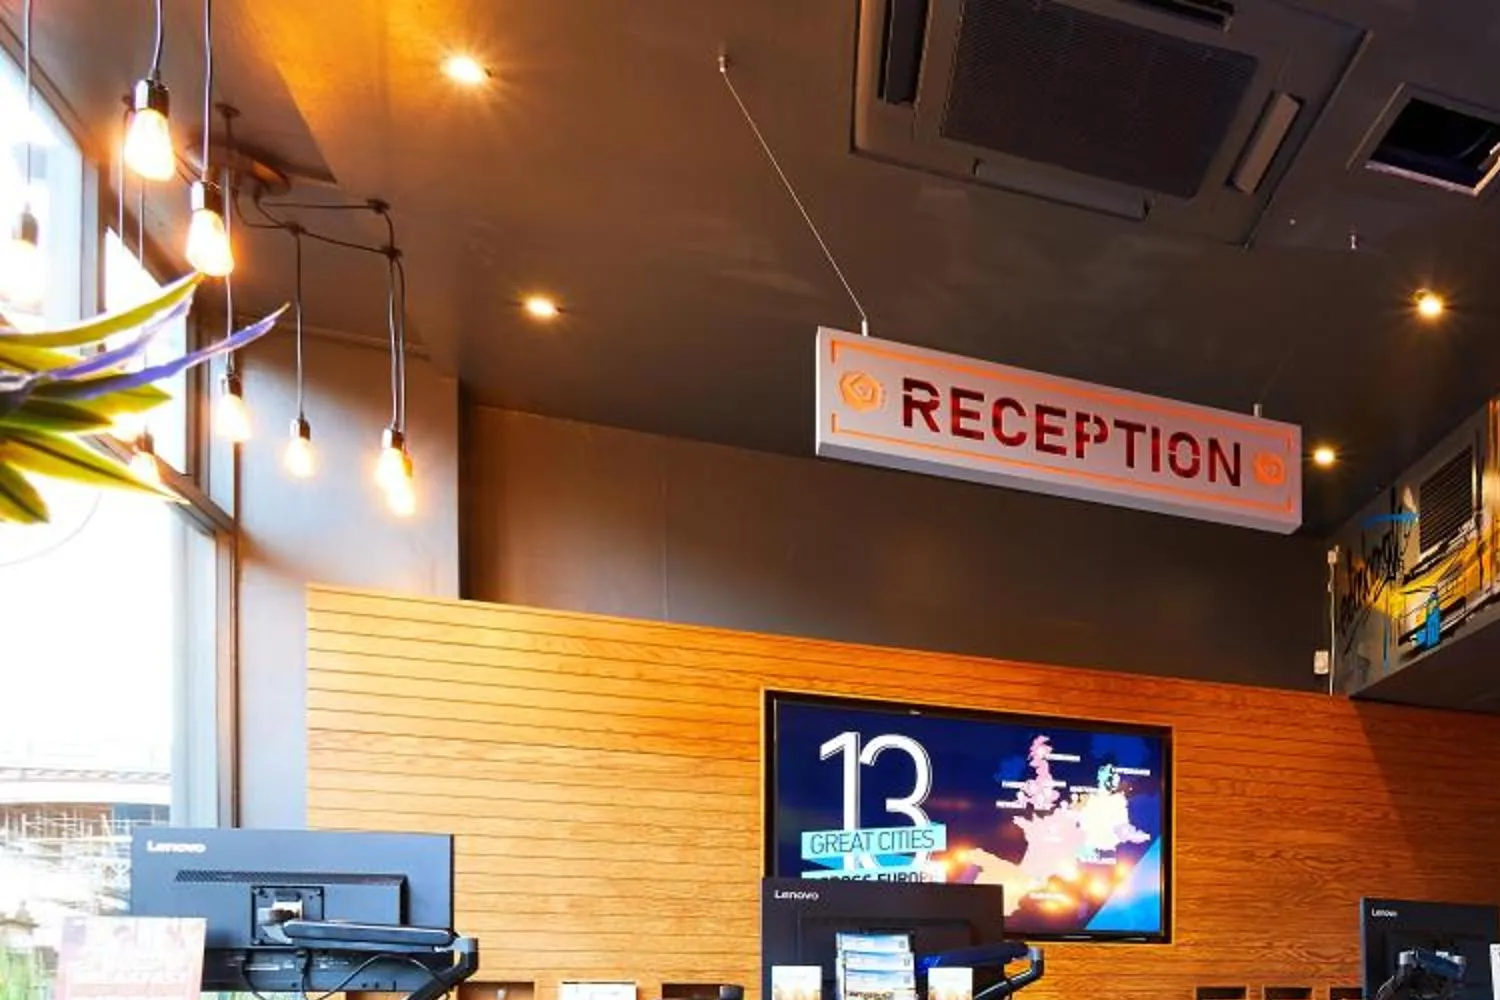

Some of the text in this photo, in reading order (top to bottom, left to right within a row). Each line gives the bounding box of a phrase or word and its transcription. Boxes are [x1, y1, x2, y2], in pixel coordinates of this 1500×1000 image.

[901, 376, 1241, 487] RECEPTION
[819, 731, 933, 872] 13
[146, 840, 207, 854] Lenovo
[810, 829, 935, 855] GREAT CITIES
[774, 889, 820, 902] Lenovo
[1371, 907, 1398, 918] Lenovo
